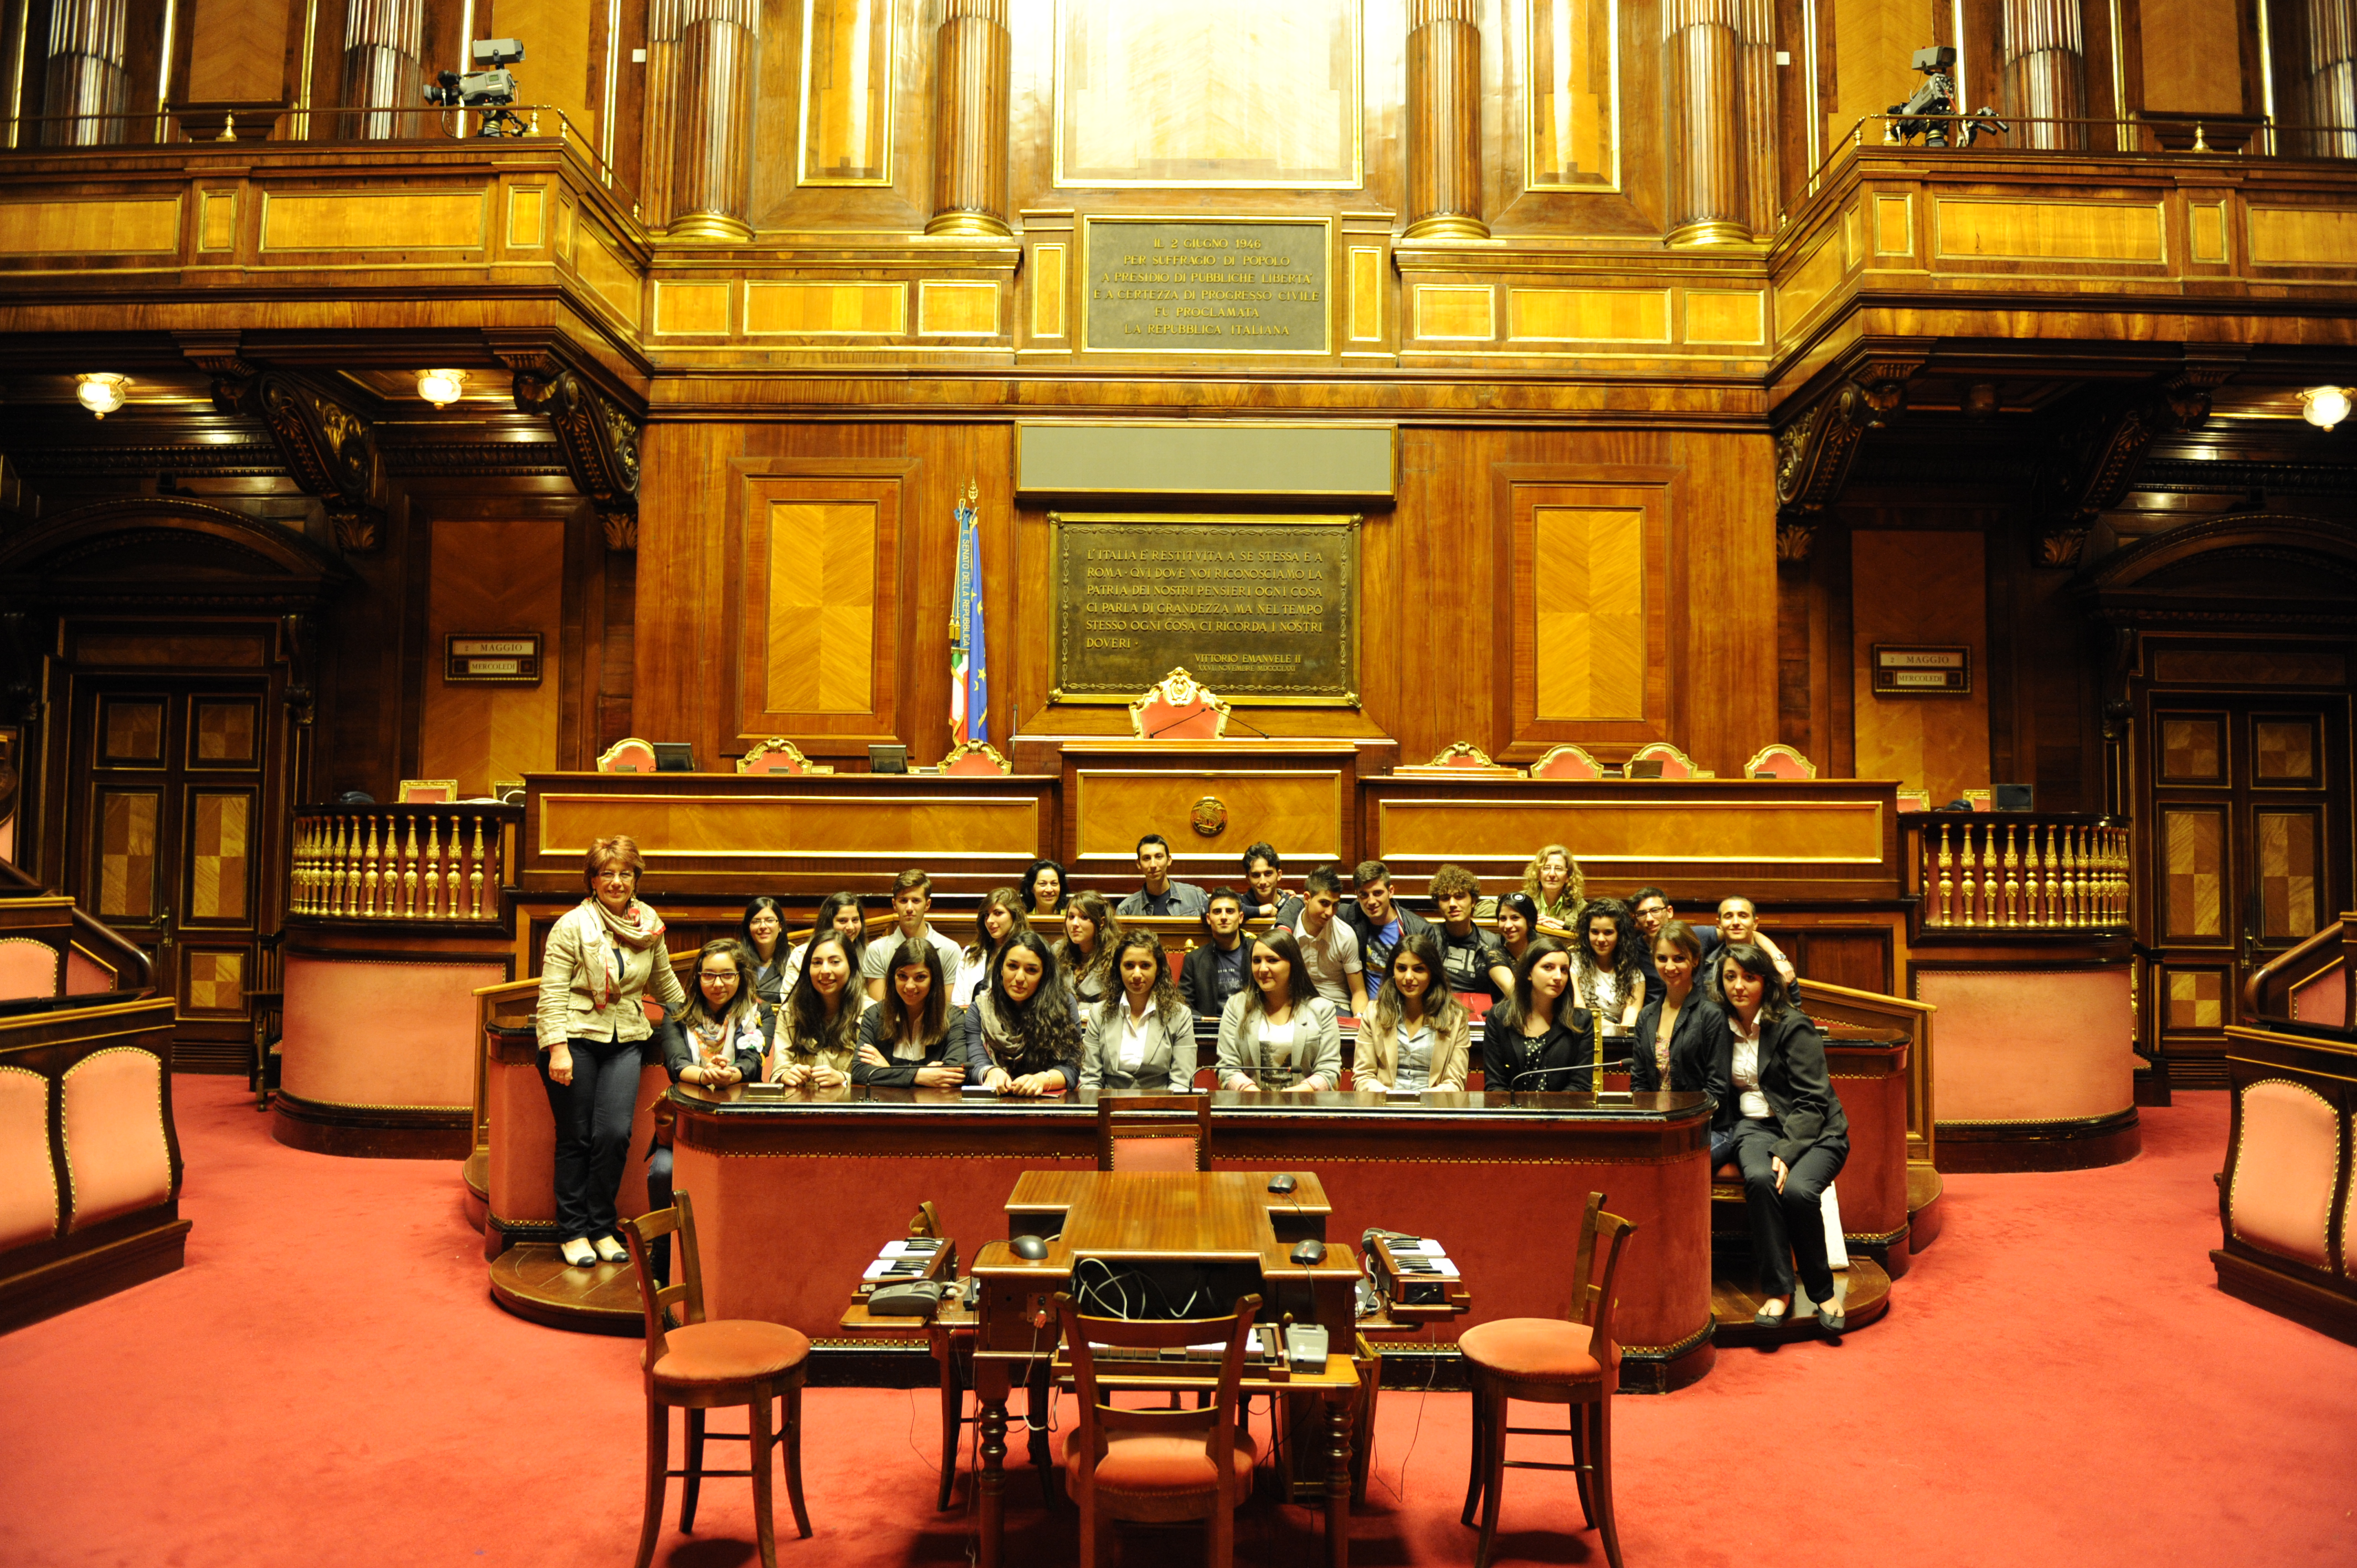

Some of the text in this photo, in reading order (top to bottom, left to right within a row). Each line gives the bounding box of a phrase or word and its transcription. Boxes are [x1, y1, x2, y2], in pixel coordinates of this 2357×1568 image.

[1153, 239, 1262, 248] IL 2 GIUGNO 1946
[1123, 255, 1291, 266] PER SUFFRAGIO DI POPOLO
[1102, 272, 1110, 282] A
[1114, 272, 1170, 282] PRESIDIO
[1174, 272, 1186, 282] DI
[1191, 273, 1254, 283] PUBBLICHE
[1093, 290, 1320, 301] E A CERTEZZA DI PROGRESSO CIVILE
[1154, 307, 1260, 317] FU PROCLAMATA
[1124, 324, 1290, 335] LA REPUBBLICA ITALIANA
[1151, 550, 1223, 560] RESTITVITA
[1227, 551, 1236, 561] A
[1239, 551, 1254, 561] SE
[1258, 551, 1300, 561] STESSA
[1304, 551, 1310, 561] E
[1315, 552, 1323, 561] A
[1087, 568, 1123, 577] ROMA
[1130, 568, 1151, 577] QVI
[1155, 568, 1186, 577] DOVE
[1190, 568, 1211, 578] NOI
[1214, 569, 1305, 579] RICONOSCIAMO
[1308, 569, 1323, 579] LA
[1087, 585, 1323, 596] PATRIA DEI NOSTRI PENSIERI OGNI COSA
[1086, 603, 1324, 614] CI PARLA DI GRANDEZZA MA NEL TEMPO
[1085, 620, 1322, 632] STESSO OGNI COSA CI RICORDA I NOSTRI
[1086, 638, 1131, 648] DOVERI
[1195, 654, 1301, 663] VITTORIO EMANVELE II
